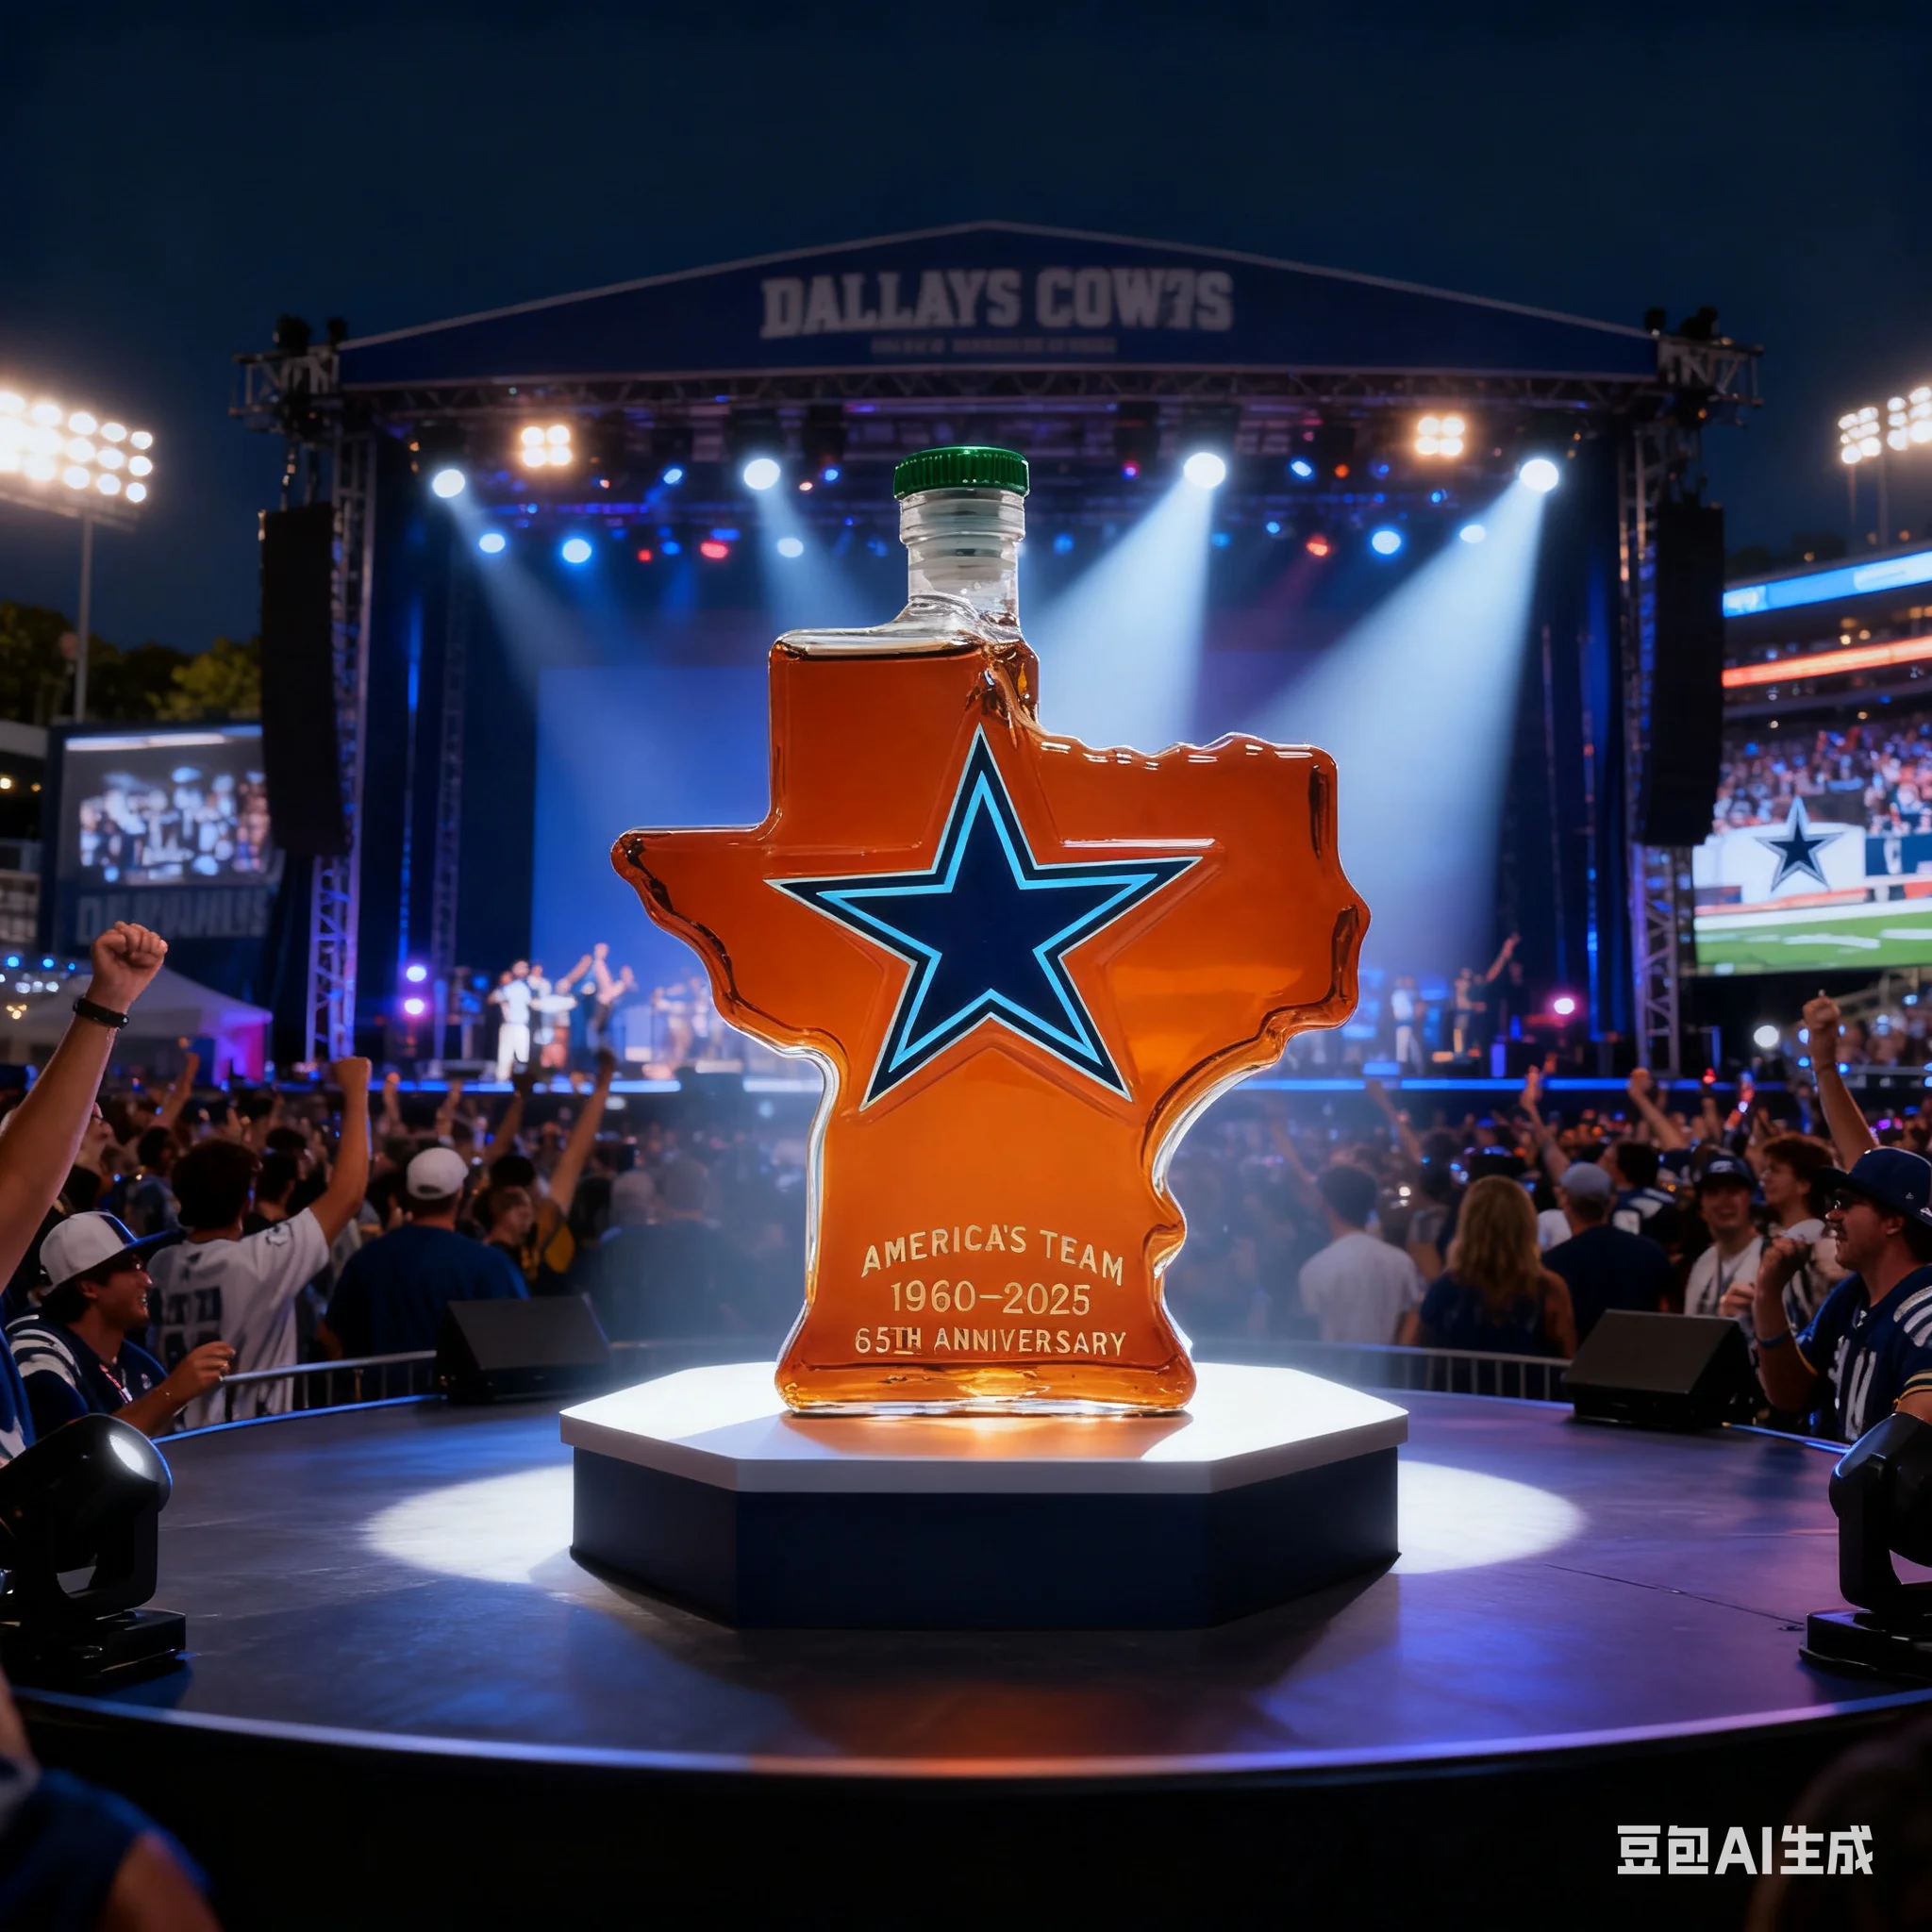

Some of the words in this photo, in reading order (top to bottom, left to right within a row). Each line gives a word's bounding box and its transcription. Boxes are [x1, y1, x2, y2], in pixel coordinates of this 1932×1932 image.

[760, 268, 1022, 339] DALLAYS
[860, 1224, 1027, 1278] AMERICA'S
[1040, 1229, 1124, 1287] TEAM
[854, 1326, 923, 1355] 65TH
[933, 1326, 1127, 1357] ANNIVERSARY
